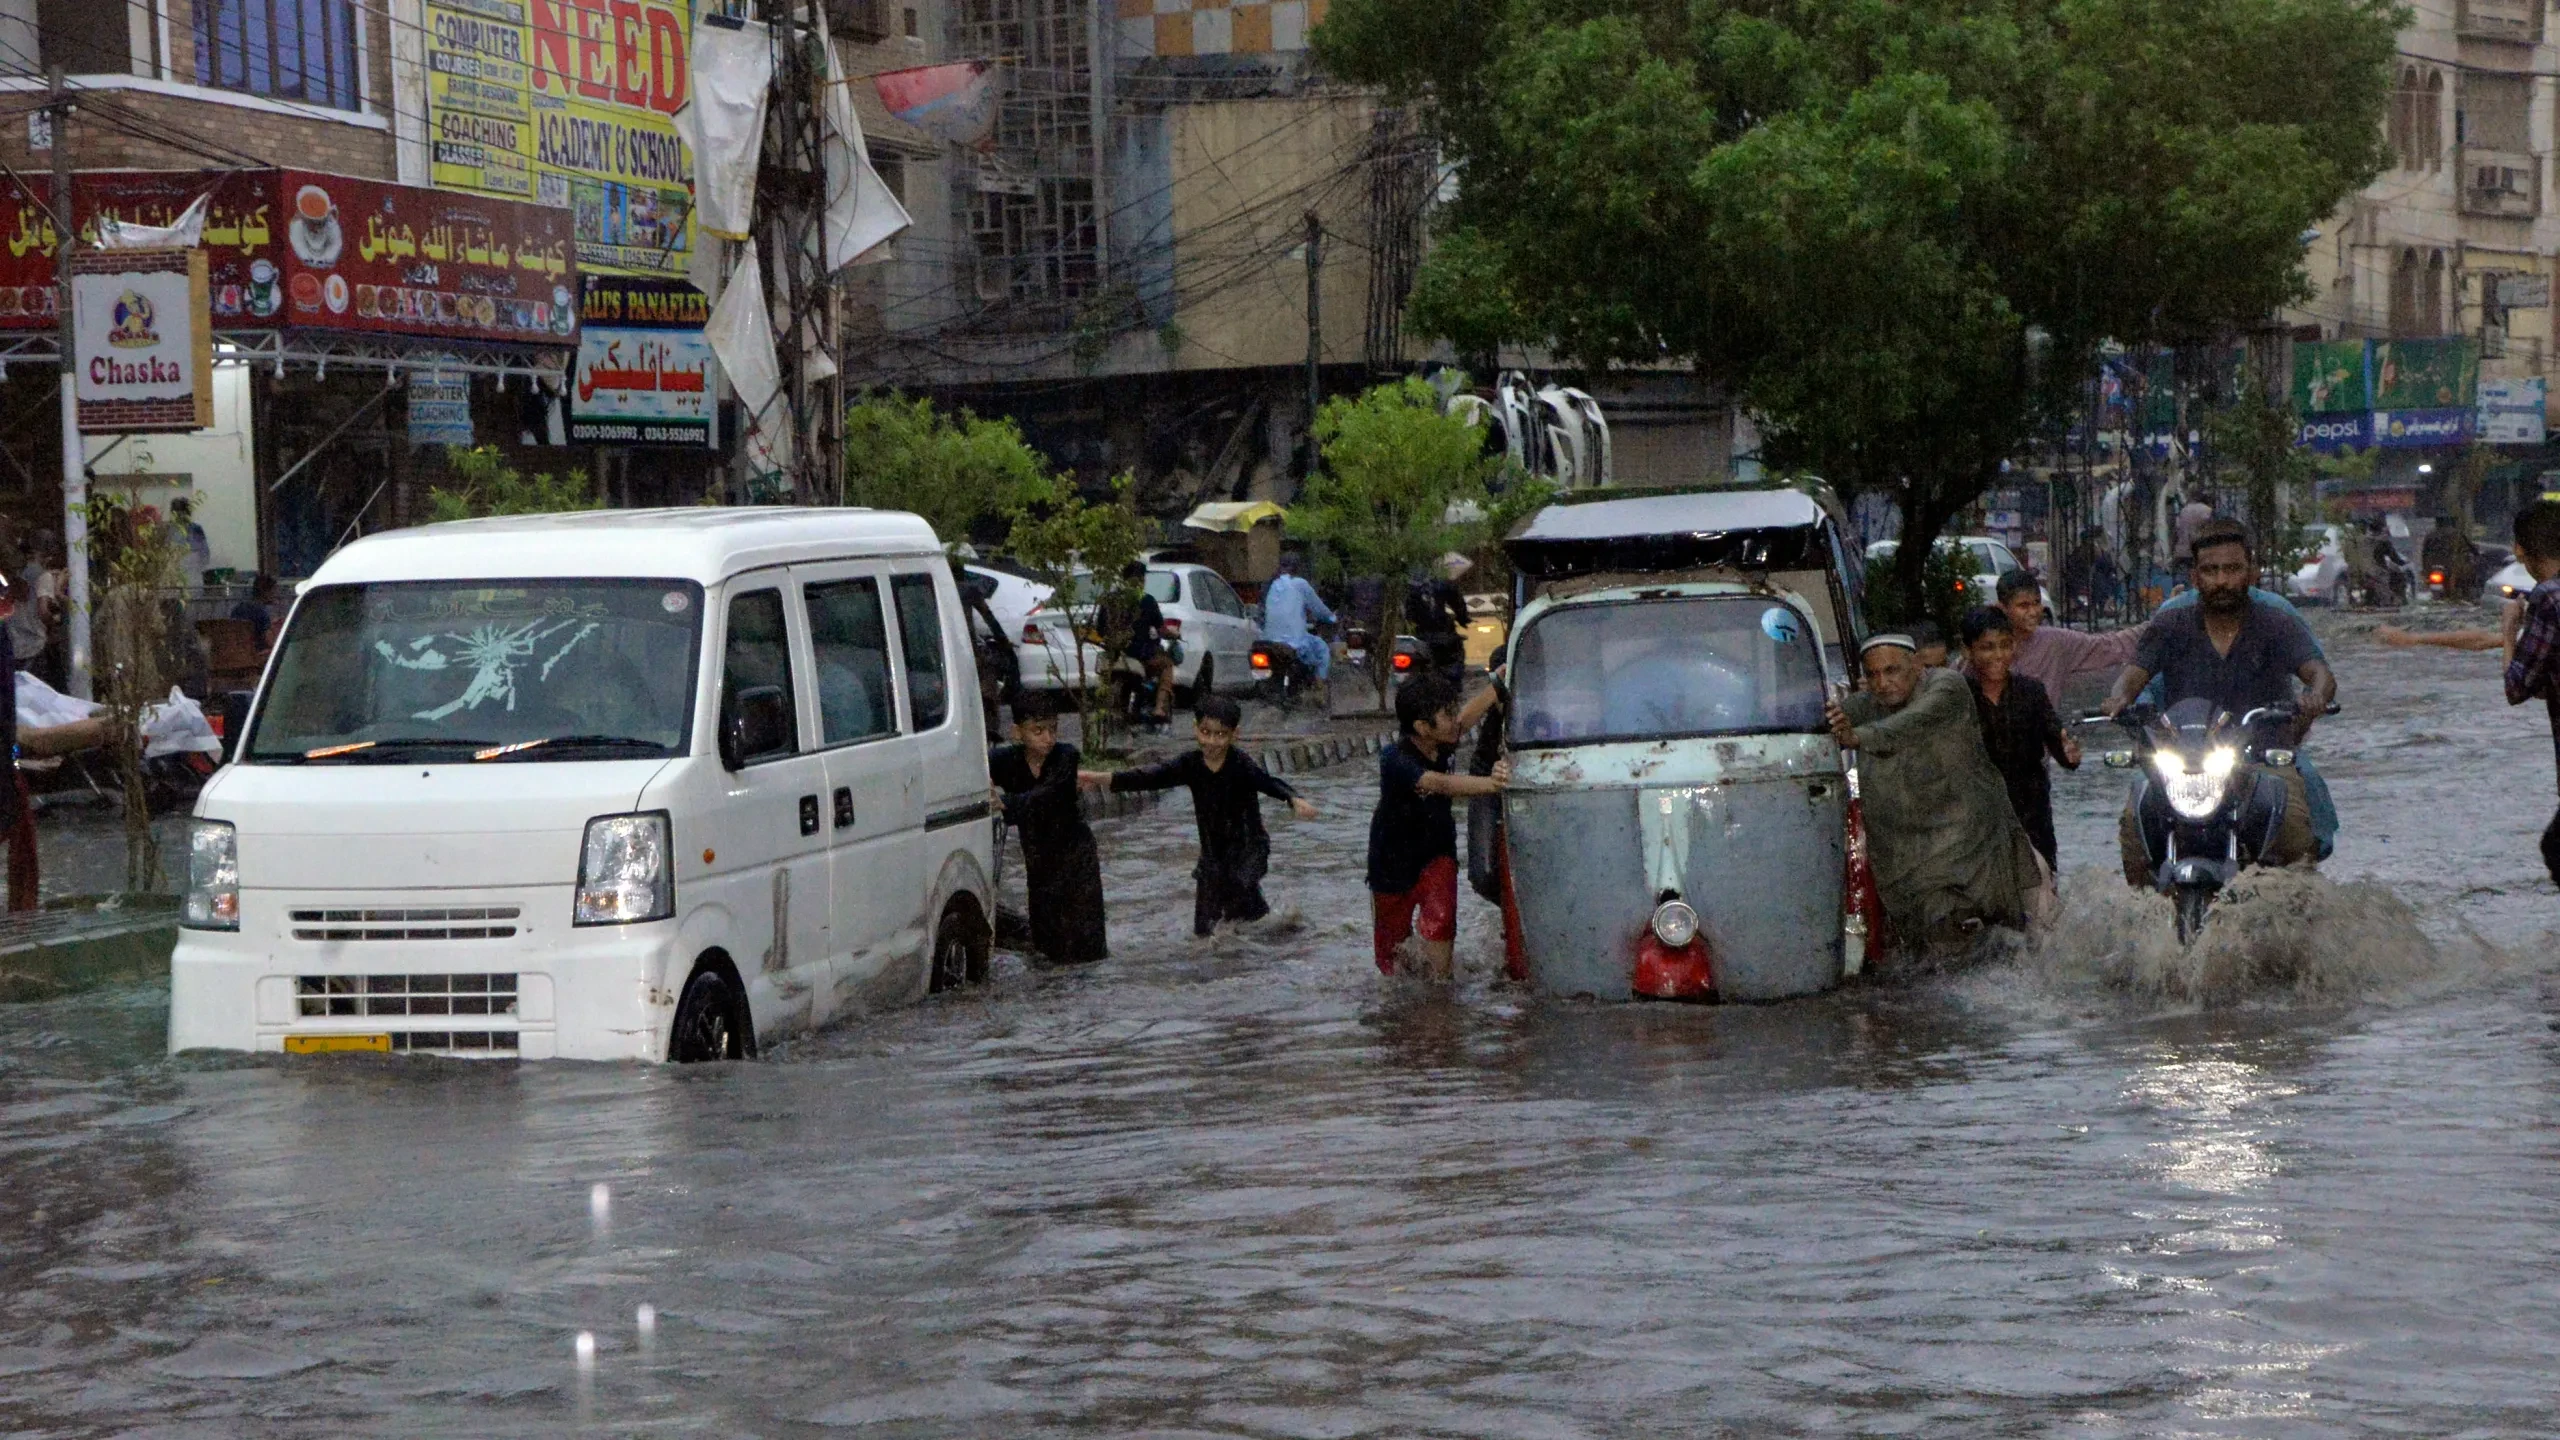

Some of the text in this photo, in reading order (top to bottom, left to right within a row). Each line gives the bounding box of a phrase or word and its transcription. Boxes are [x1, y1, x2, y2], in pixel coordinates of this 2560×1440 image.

[435, 13, 520, 61] COMPUTER
[435, 53, 480, 77] COURSES
[531, 0, 686, 113] NEED
[441, 113, 517, 149] COACHING
[538, 112, 686, 183] ACADEMY & SCHOOL
[583, 290, 708, 322] ALI'S PANAFLEX
[89, 355, 181, 385] Chaska
[2303, 420, 2360, 440] pepsi
